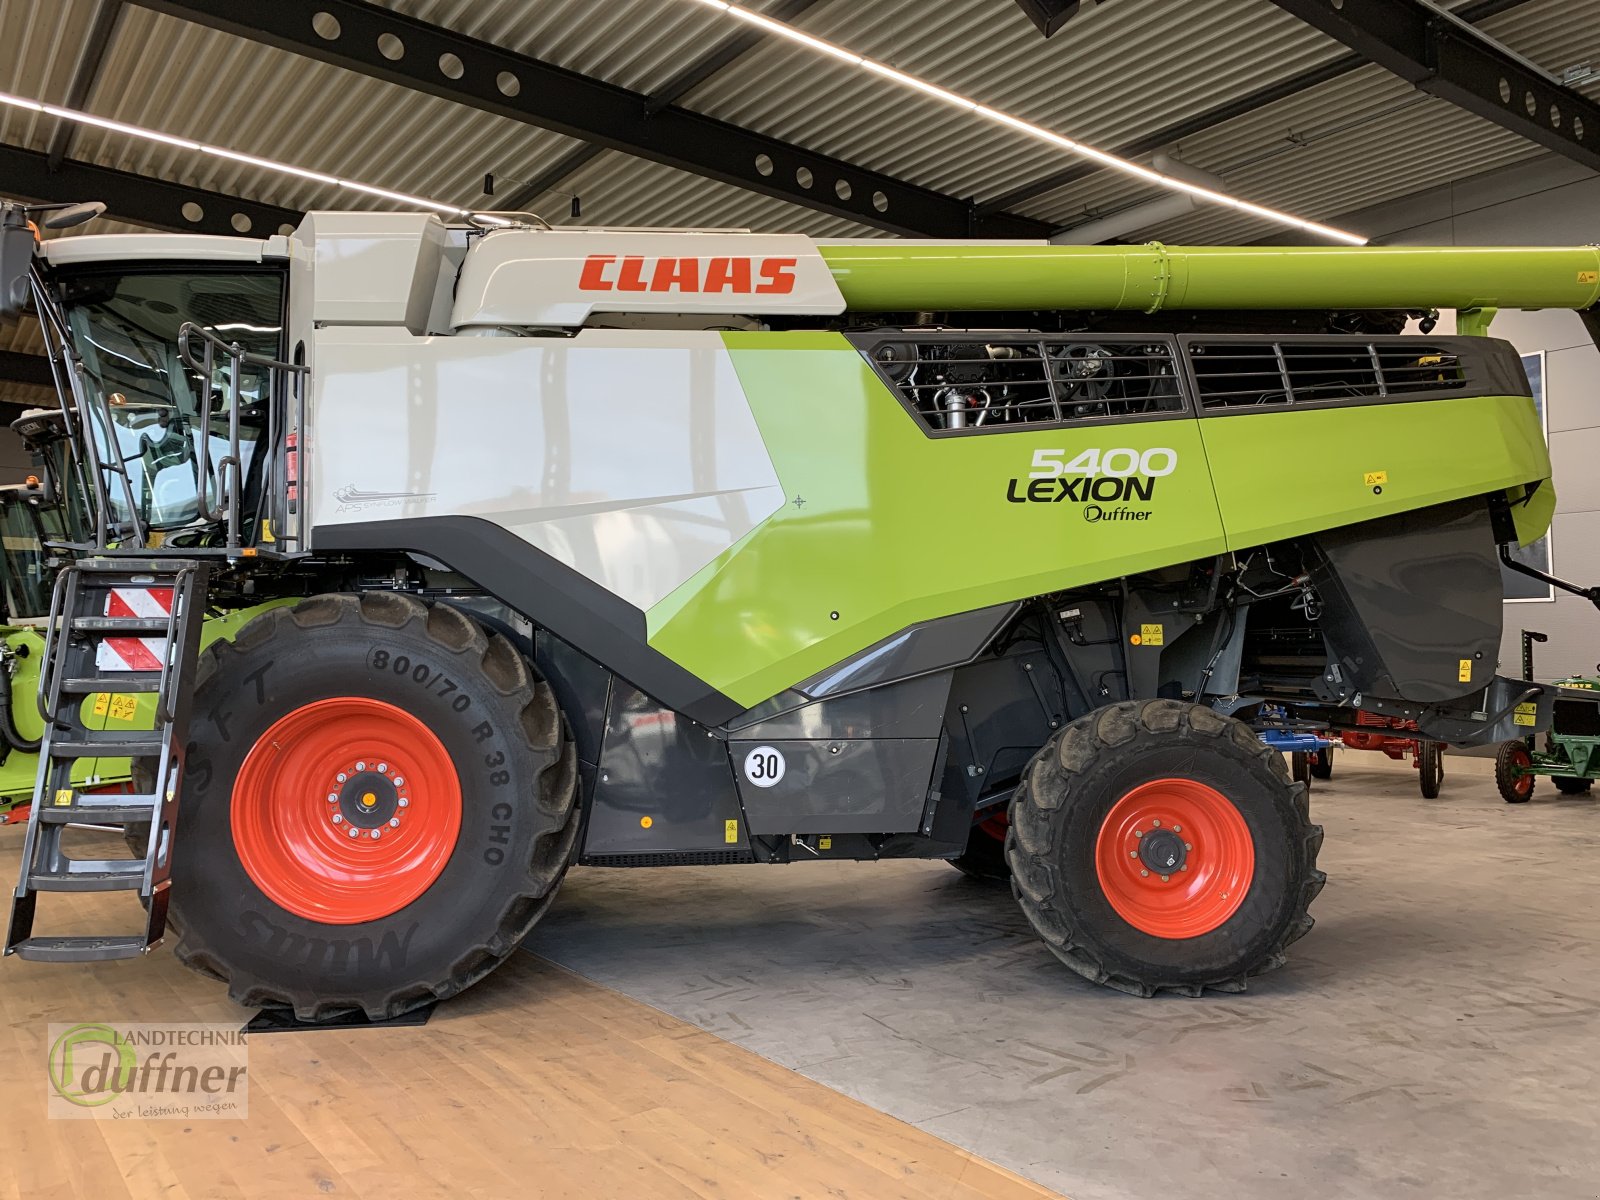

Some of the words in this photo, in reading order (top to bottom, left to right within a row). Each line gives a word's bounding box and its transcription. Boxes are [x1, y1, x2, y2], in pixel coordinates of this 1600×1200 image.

[578, 254, 798, 294] CLAAS
[1028, 447, 1178, 479] 5400
[1006, 476, 1155, 502] LEXION
[335, 503, 362, 514] APS
[1083, 504, 1153, 523] Duffner
[372, 649, 472, 713] 800/70
[470, 720, 494, 744] R
[484, 750, 511, 787] 38
[751, 753, 778, 779] 30
[483, 802, 513, 866] CHO
